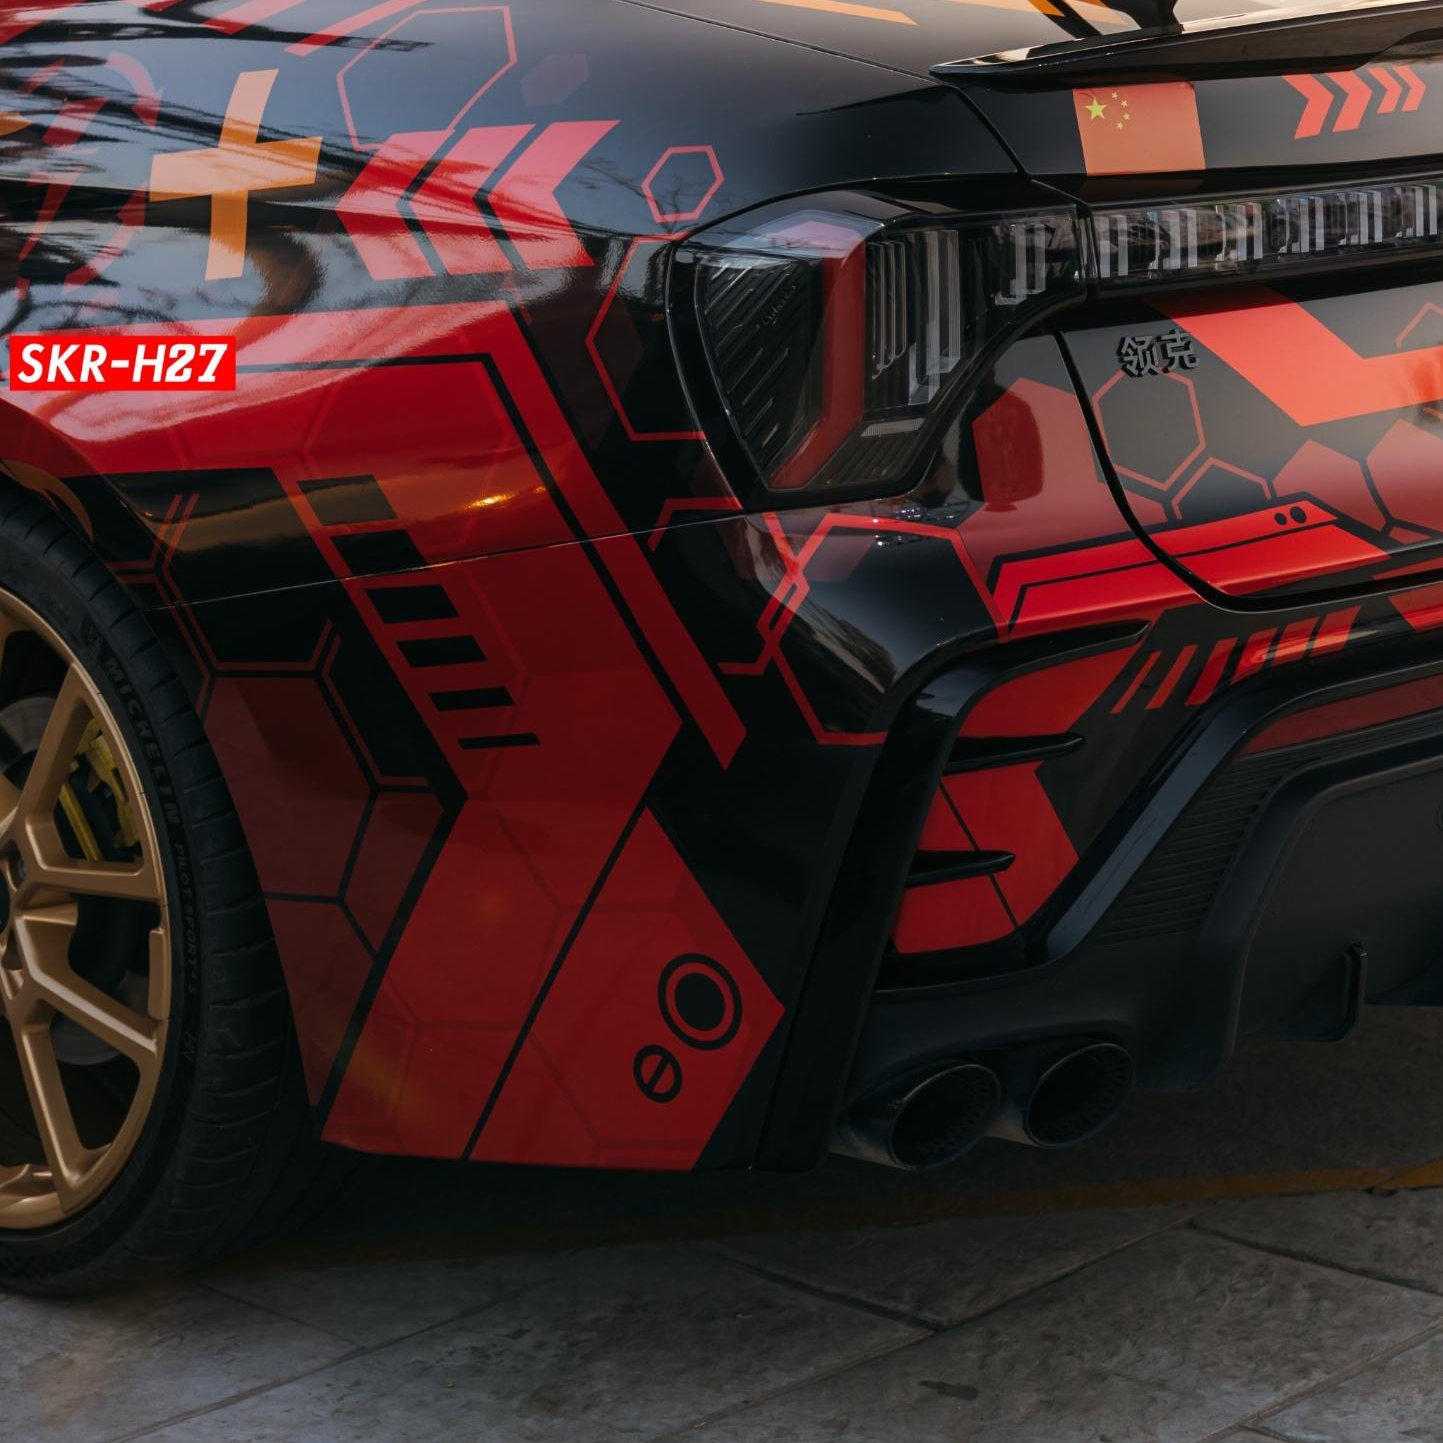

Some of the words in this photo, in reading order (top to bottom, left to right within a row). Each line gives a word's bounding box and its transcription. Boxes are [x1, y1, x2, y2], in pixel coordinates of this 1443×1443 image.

[1117, 329, 1202, 378] 领克
[104, 658, 181, 827] MICHELIN
[184, 902, 198, 970] SPORT
